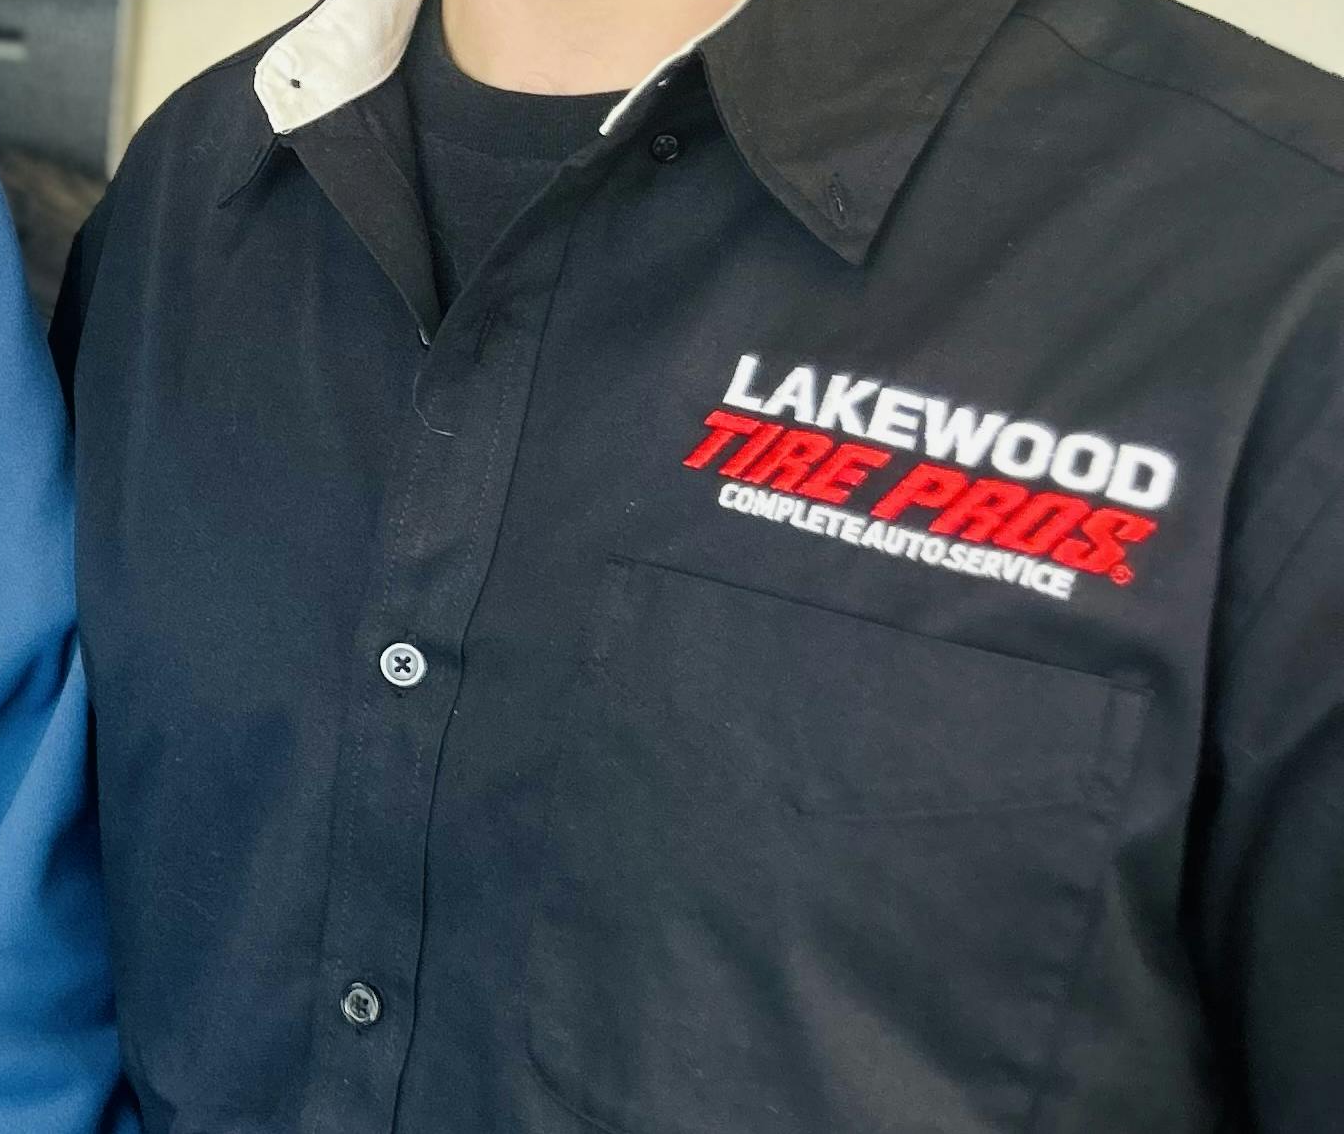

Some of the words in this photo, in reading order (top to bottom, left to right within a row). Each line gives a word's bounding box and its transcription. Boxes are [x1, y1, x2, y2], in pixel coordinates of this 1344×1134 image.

[682, 410, 892, 504] TIRE
[721, 354, 1179, 511] LAKEWOOD
[717, 483, 868, 547] COMPLETE
[860, 521, 949, 566] AUTO
[940, 544, 1078, 602] SERVICE
